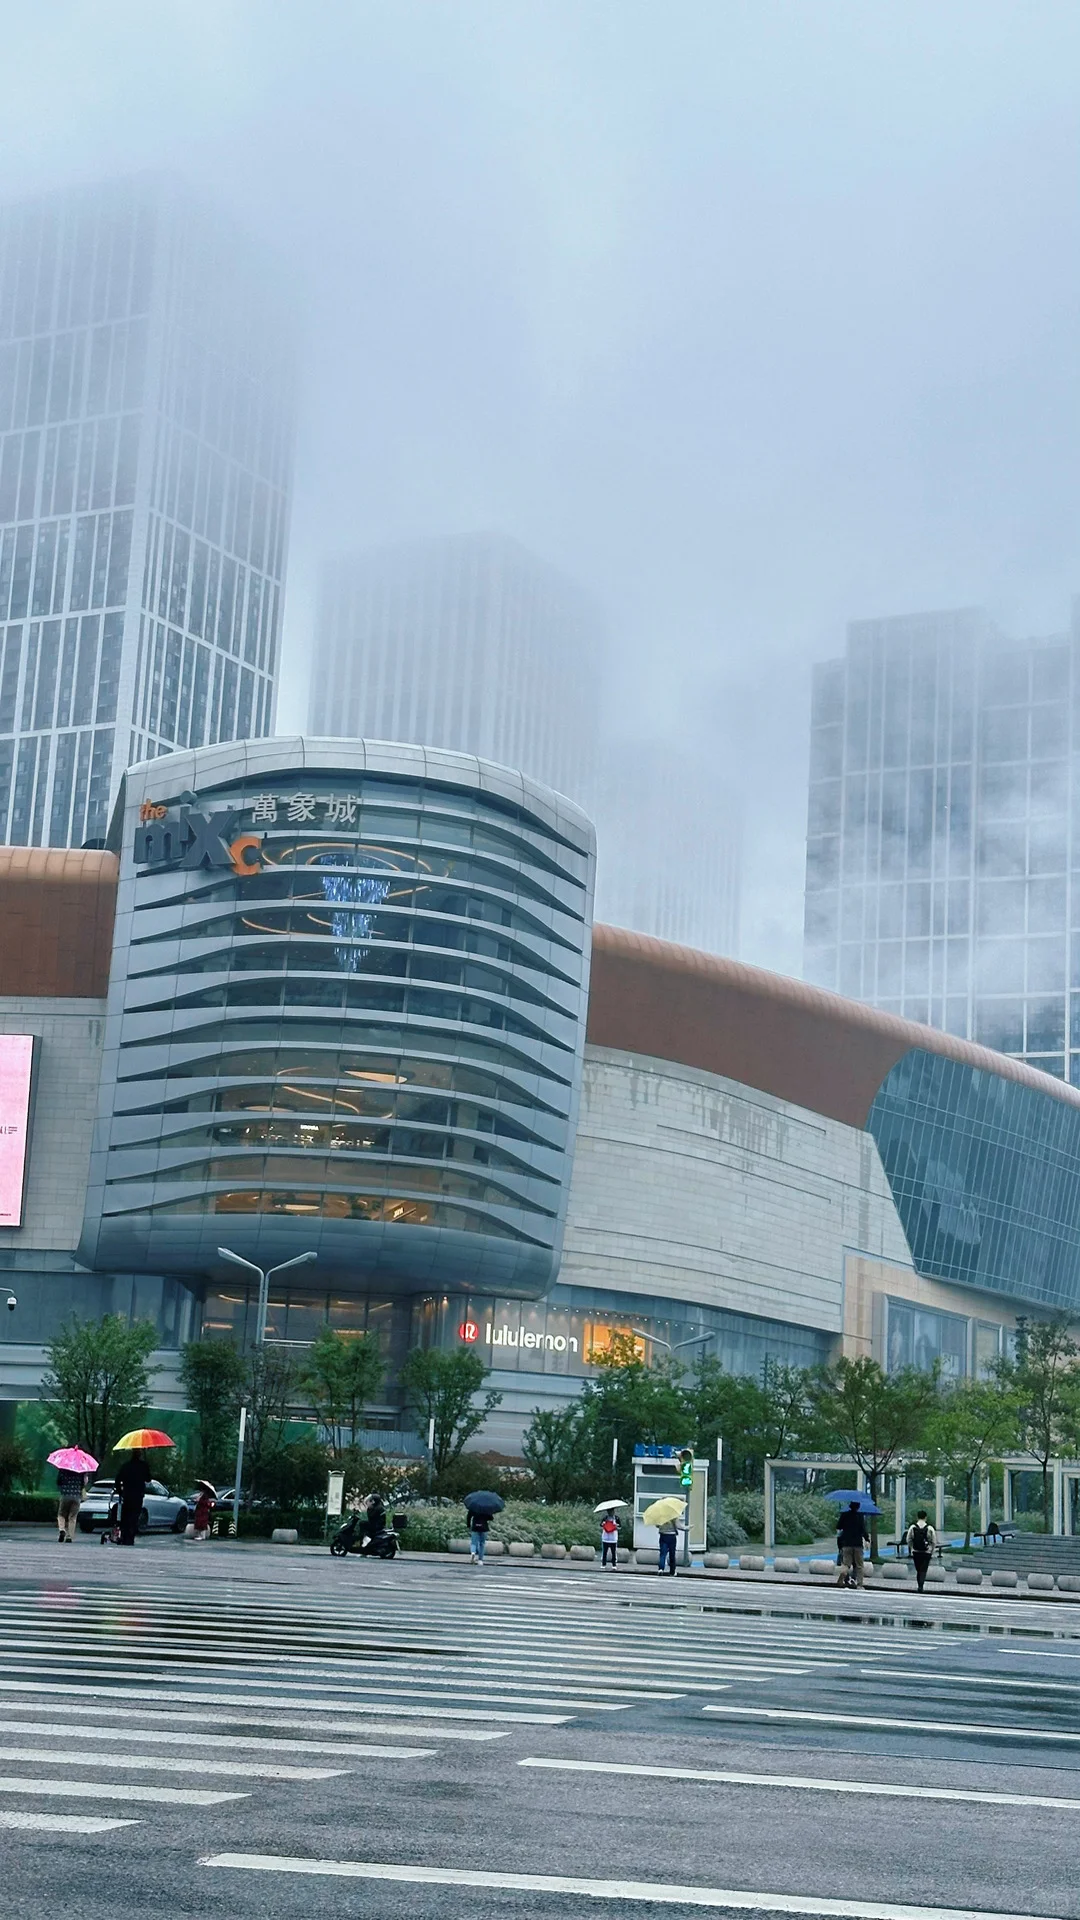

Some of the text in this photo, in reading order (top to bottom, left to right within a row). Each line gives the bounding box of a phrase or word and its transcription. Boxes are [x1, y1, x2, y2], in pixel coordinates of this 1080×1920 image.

[139, 798, 168, 821] the
[251, 792, 358, 823] 萬象城
[485, 1323, 579, 1353] lululemon
